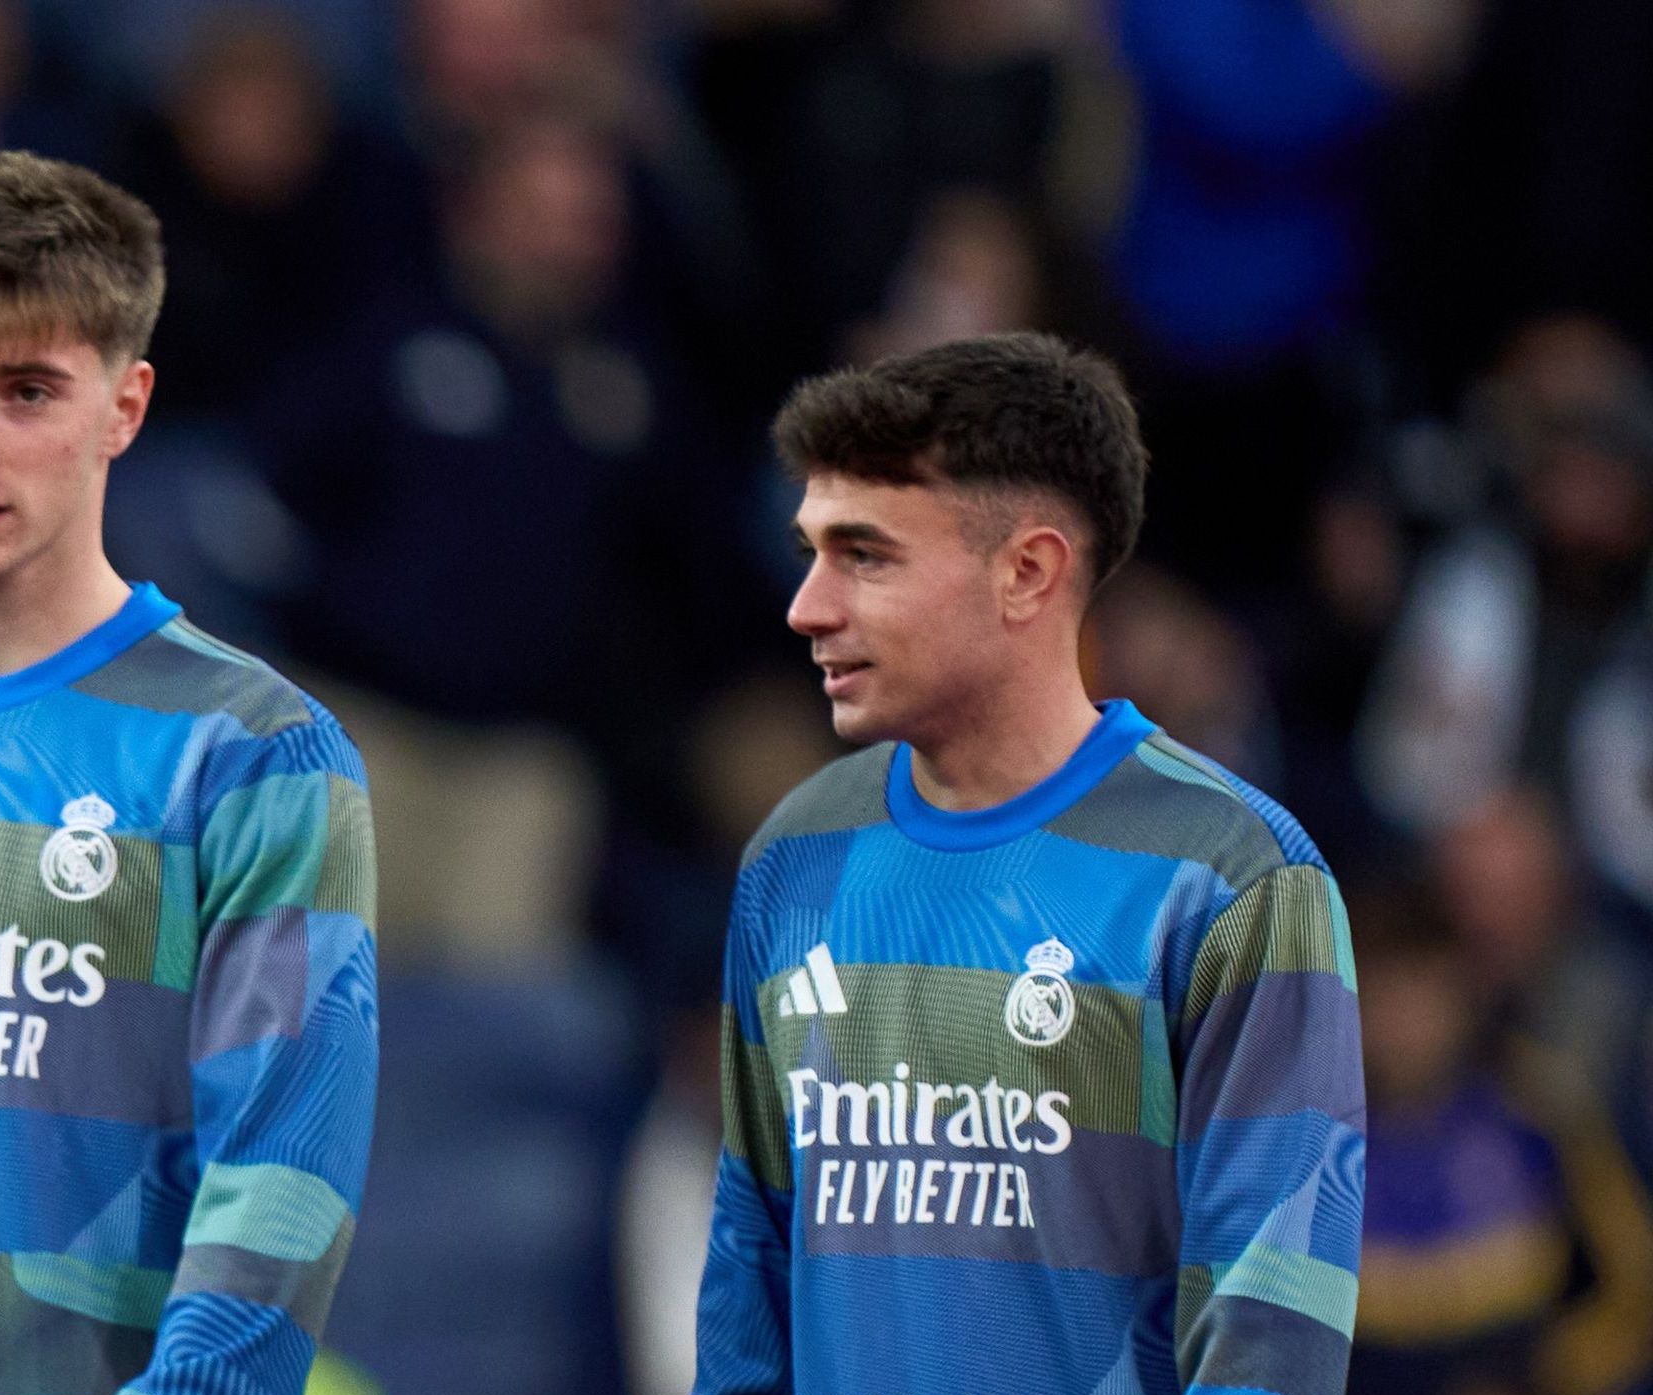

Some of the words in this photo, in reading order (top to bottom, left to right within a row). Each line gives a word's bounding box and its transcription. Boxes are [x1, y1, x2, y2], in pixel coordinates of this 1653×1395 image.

[787, 1062, 1072, 1155] Emirates
[815, 1160, 890, 1226] FLY
[895, 1159, 1036, 1229] BETTER
